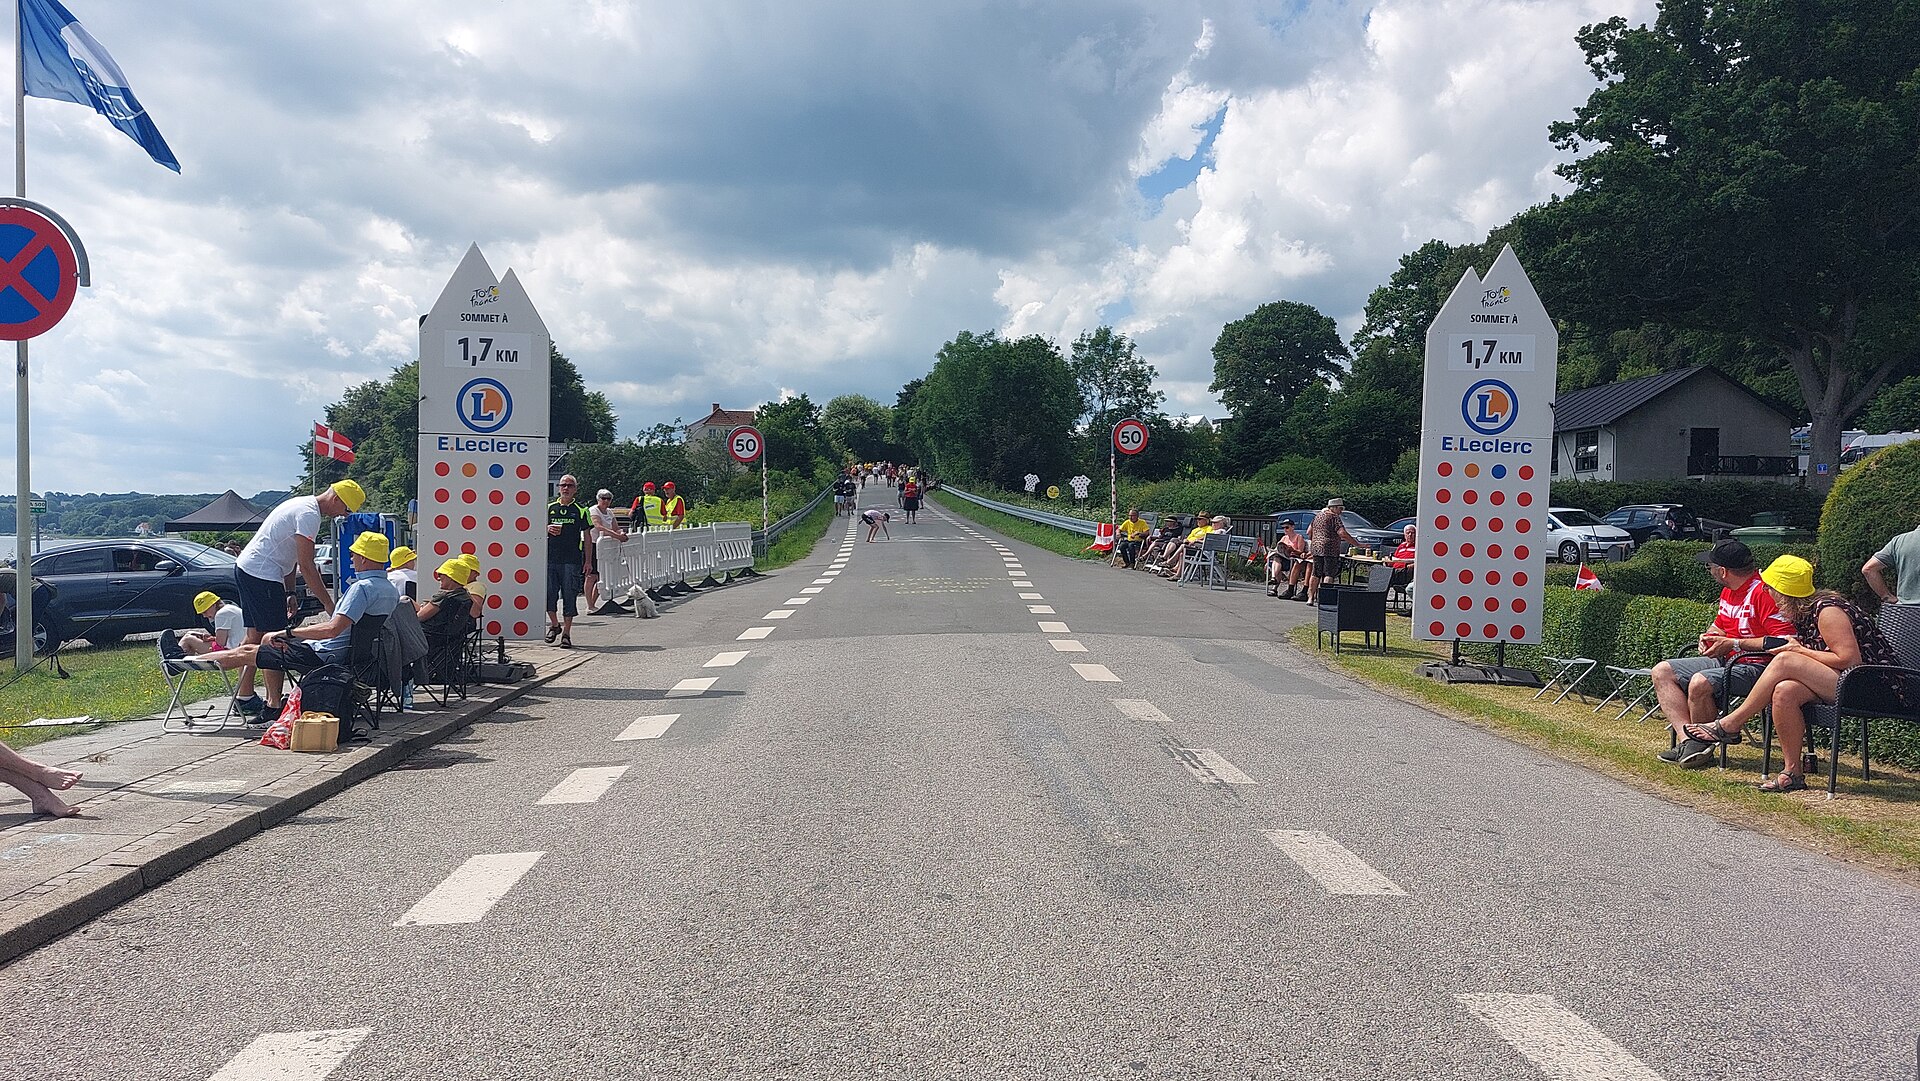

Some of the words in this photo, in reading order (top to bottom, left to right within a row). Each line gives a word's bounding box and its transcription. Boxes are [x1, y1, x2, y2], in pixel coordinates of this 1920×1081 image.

[460, 313, 500, 323] SOMMET
[502, 312, 509, 323] À
[1470, 314, 1510, 324] SOMMET
[1512, 313, 1518, 324] À
[458, 337, 494, 366] 1,7
[496, 349, 519, 363] KM
[1461, 340, 1498, 369] 1,7
[1499, 351, 1522, 364] KM
[471, 392, 494, 422] L
[1475, 394, 1499, 424] L
[437, 436, 528, 454] E.Leclerc
[735, 438, 757, 452] 50
[1120, 430, 1142, 444] 50
[1442, 436, 1533, 454] E.Leclerc
[1605, 463, 1612, 471] 45
